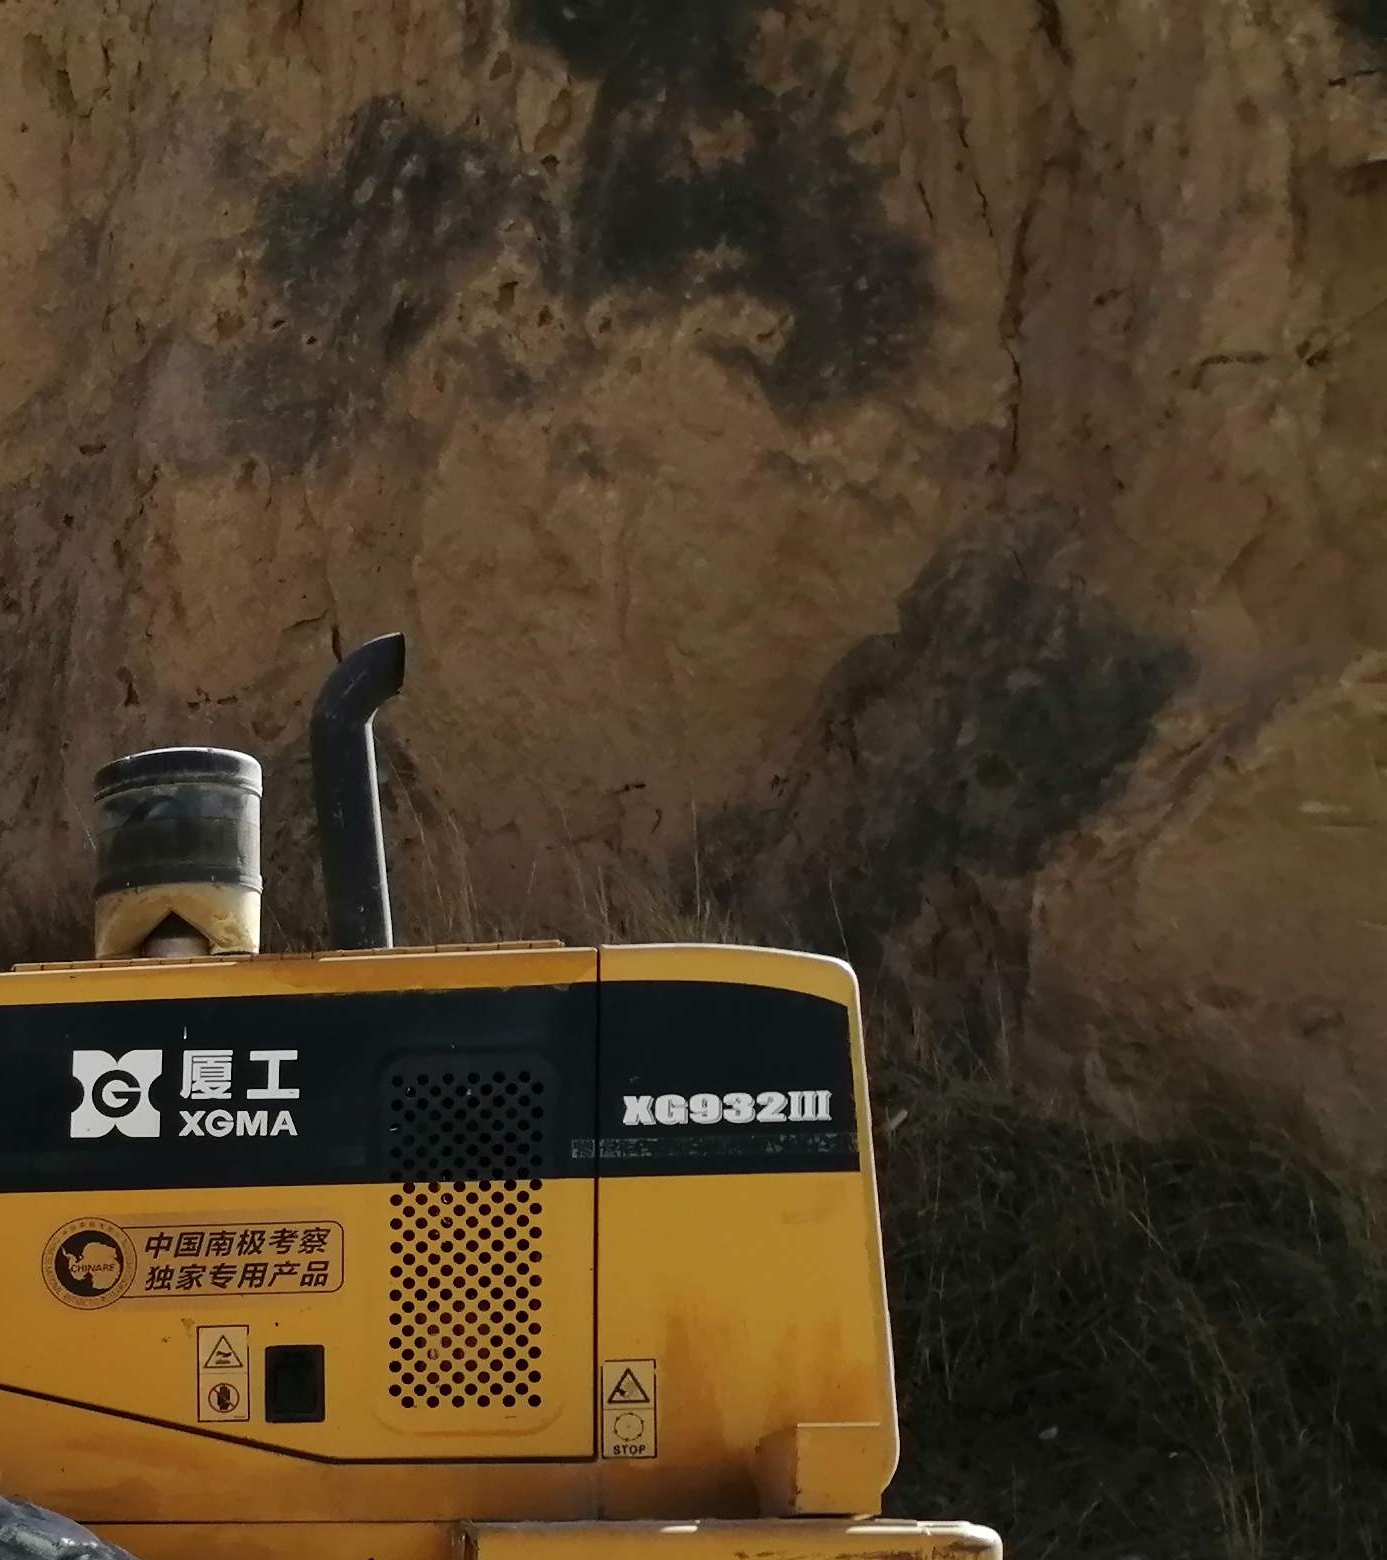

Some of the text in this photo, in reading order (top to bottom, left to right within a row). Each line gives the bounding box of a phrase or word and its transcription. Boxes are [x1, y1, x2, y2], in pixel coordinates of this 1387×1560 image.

[180, 1050, 300, 1100] 厦工
[178, 1109, 298, 1138] XGMA
[144, 1227, 331, 1259] 中国南极考察
[145, 1260, 330, 1291] 独家专用产品
[613, 1444, 646, 1455] STOP
